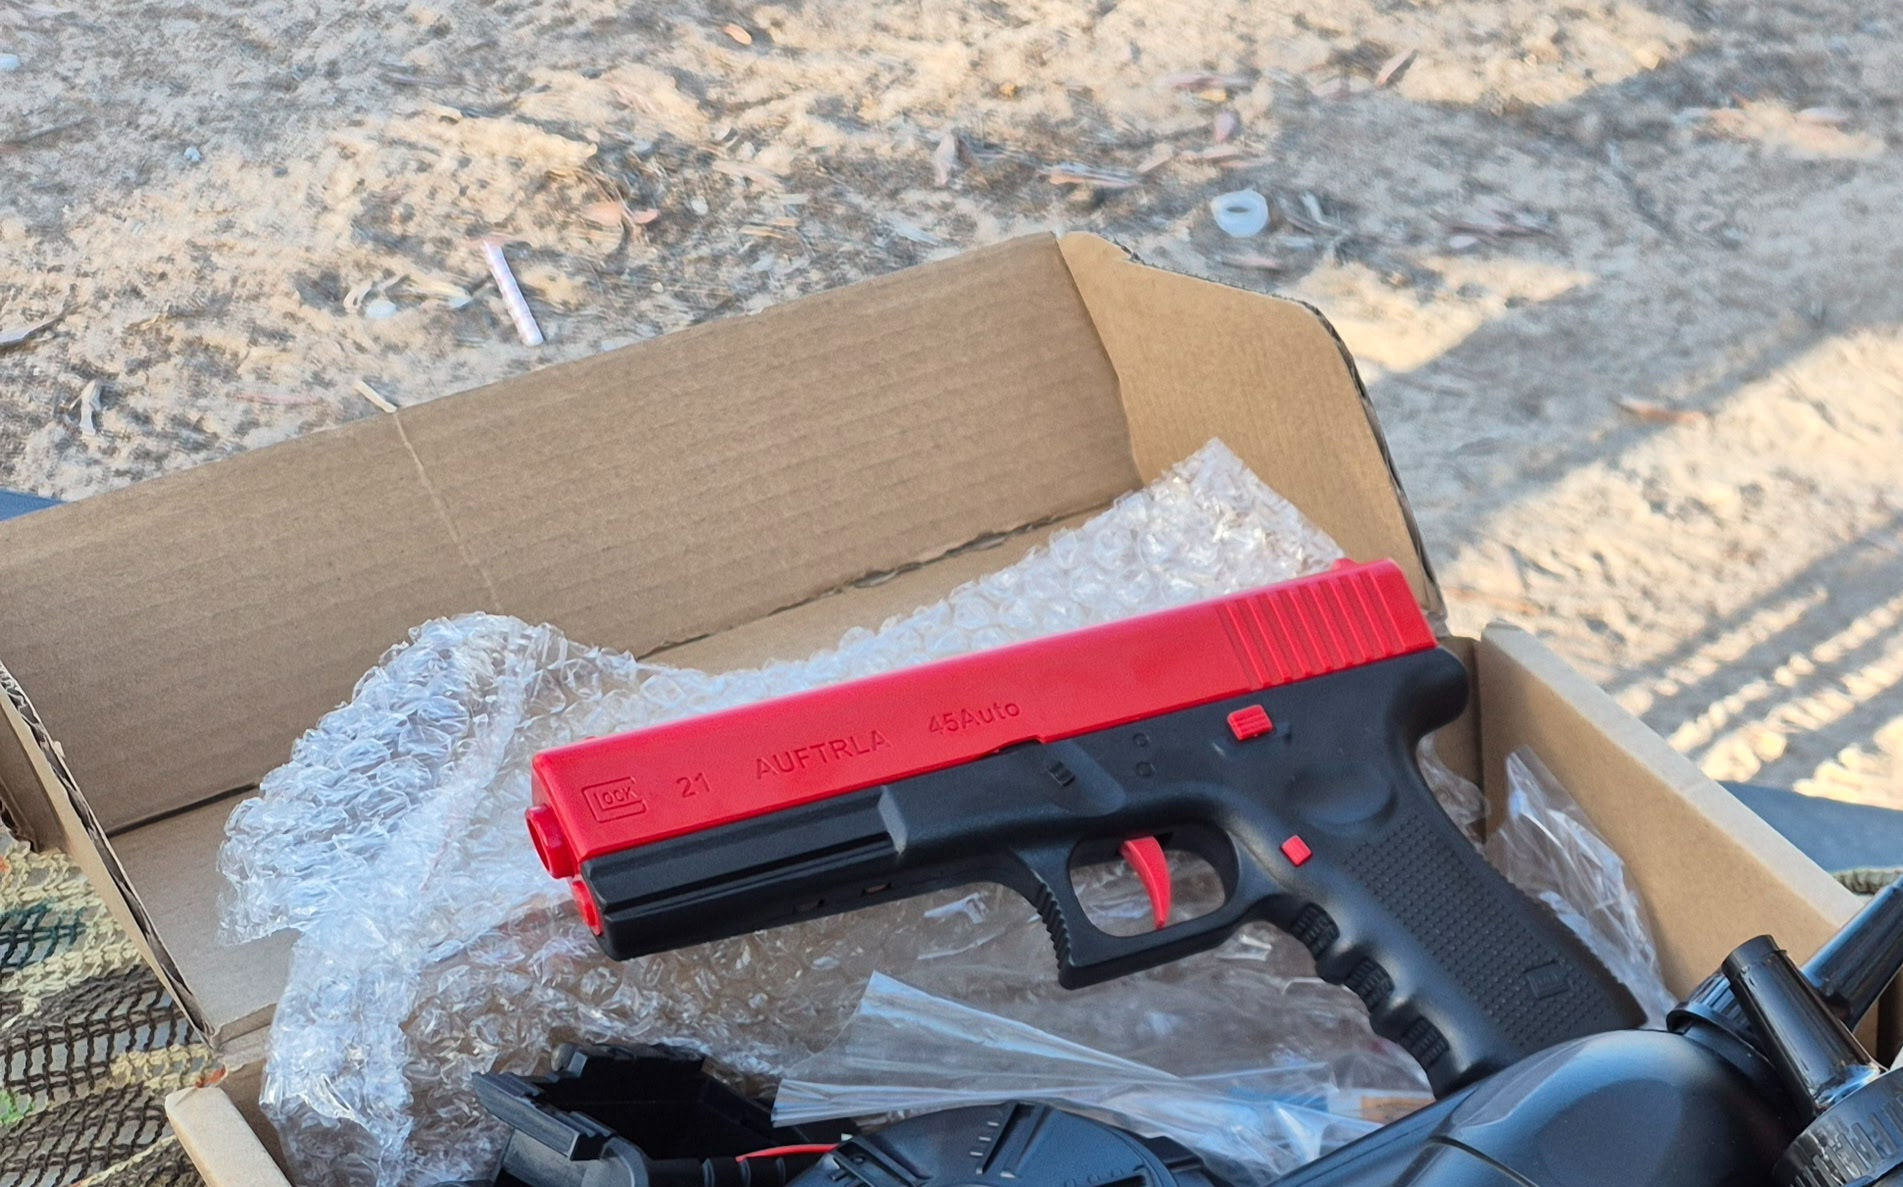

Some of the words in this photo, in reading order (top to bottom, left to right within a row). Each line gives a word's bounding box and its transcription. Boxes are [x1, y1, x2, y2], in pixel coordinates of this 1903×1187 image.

[675, 772, 711, 799] 21
[755, 729, 891, 780] AUFTRLA
[928, 701, 1021, 734] 45Auto
